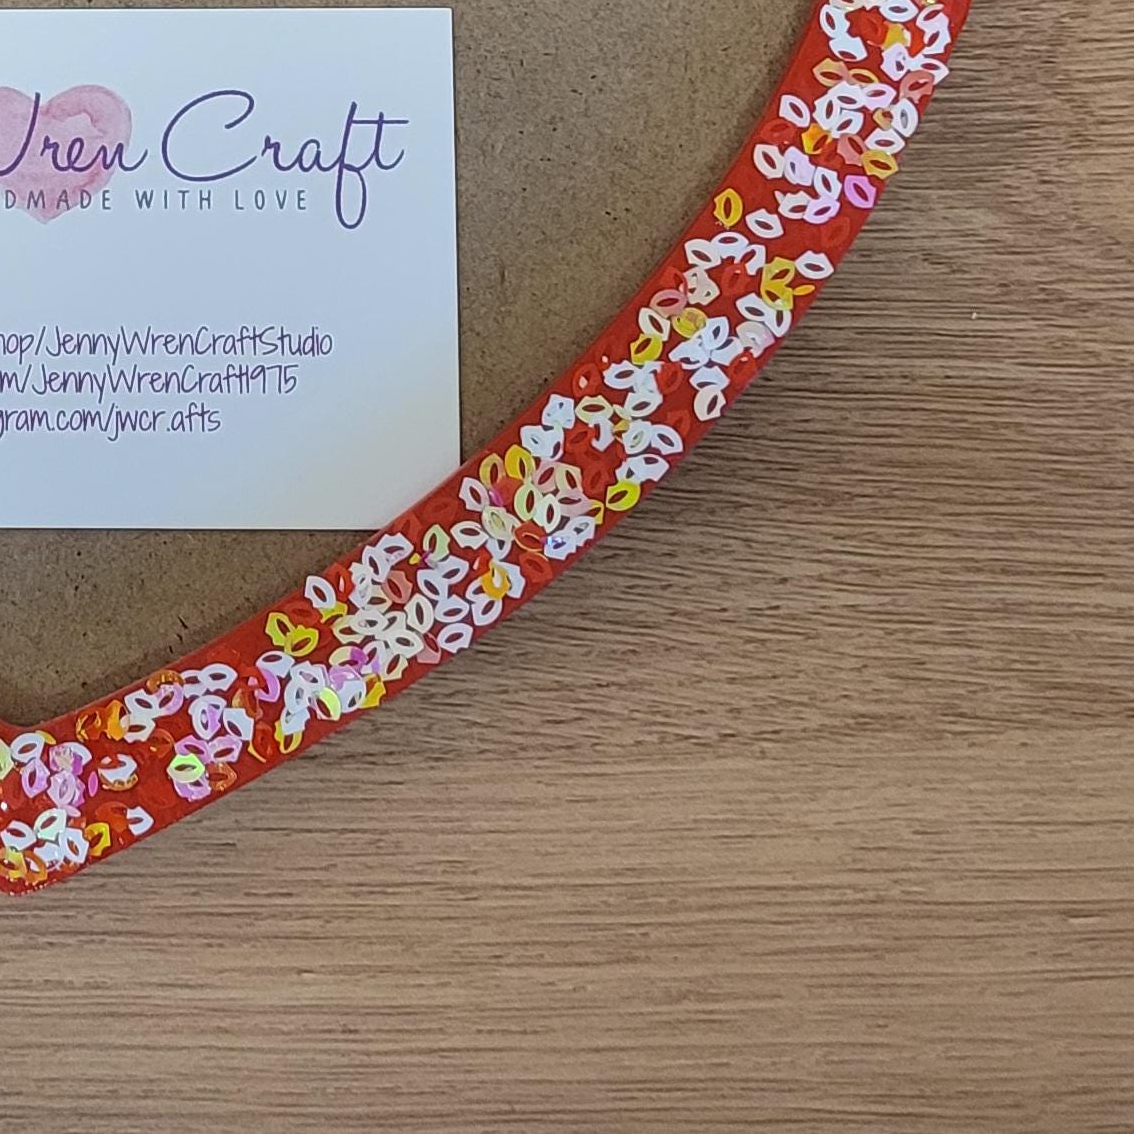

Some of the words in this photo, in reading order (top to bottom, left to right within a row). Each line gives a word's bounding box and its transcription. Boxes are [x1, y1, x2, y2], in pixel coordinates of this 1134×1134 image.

[161, 89, 409, 229] Craft
[135, 189, 212, 211] WITH
[234, 189, 309, 211] LOVE
